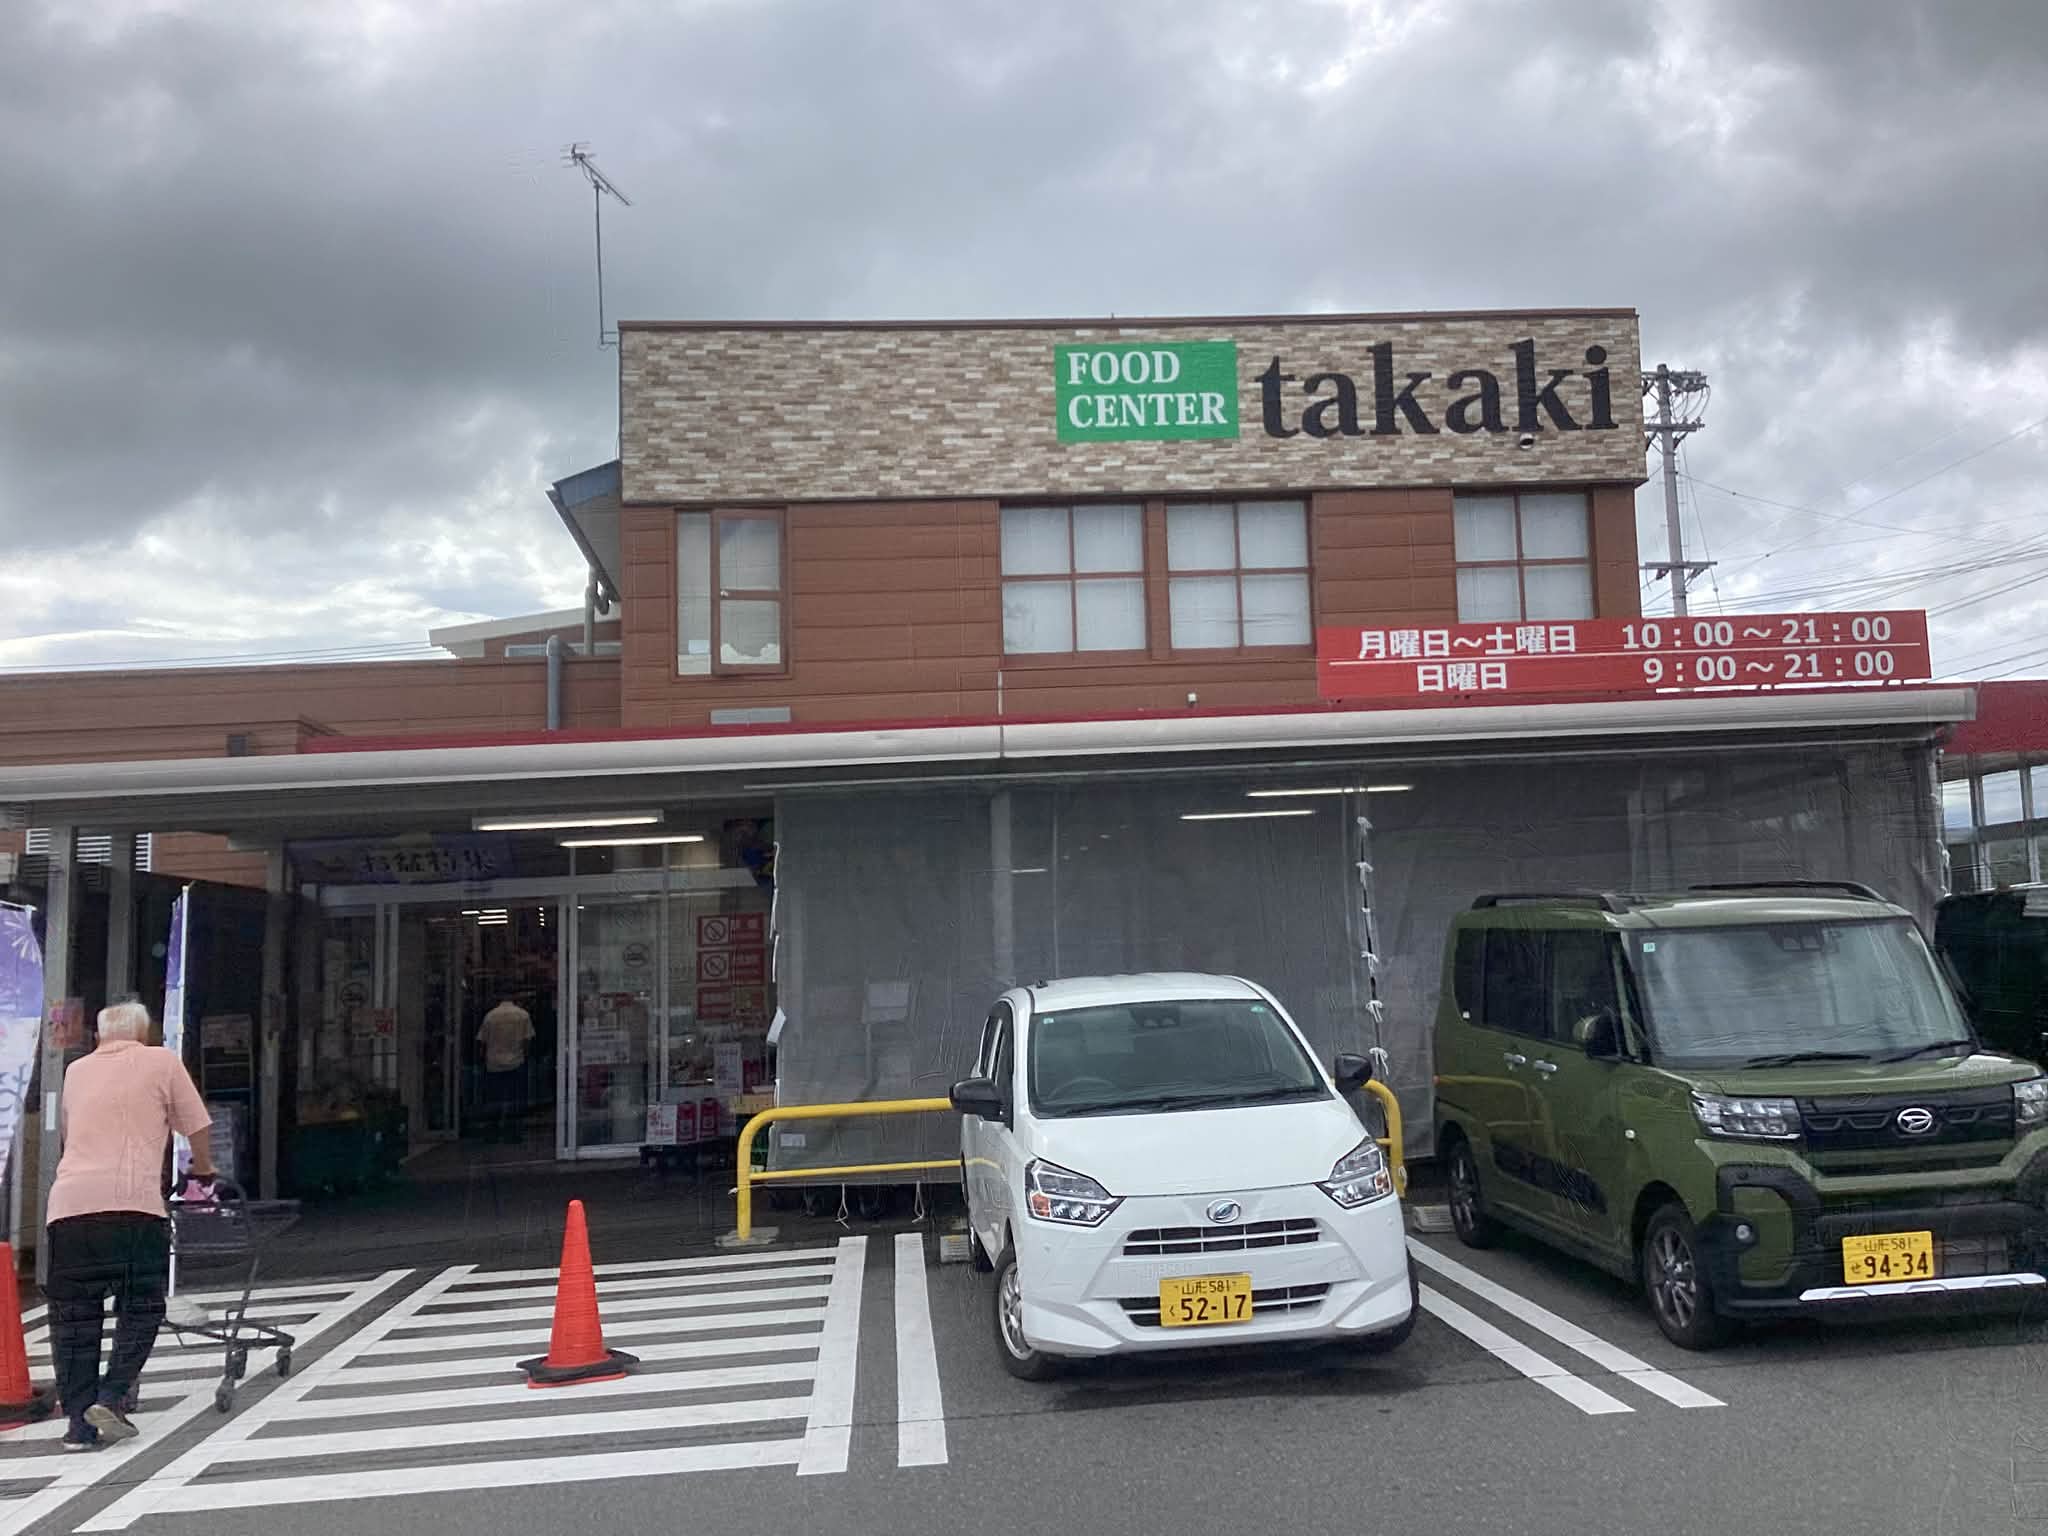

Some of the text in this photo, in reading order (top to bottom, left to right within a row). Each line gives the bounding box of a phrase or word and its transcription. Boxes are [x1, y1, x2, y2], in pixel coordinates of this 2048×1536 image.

[1067, 350, 1180, 385] FOOD
[1255, 338, 1619, 438] takaki
[1067, 392, 1227, 428] CENTER
[1359, 625, 1577, 659] 月曜日～土曜日
[1417, 662, 1508, 692] 日曜日
[1864, 1251, 1928, 1278] 94-34
[1181, 1294, 1247, 1321] 52-17
